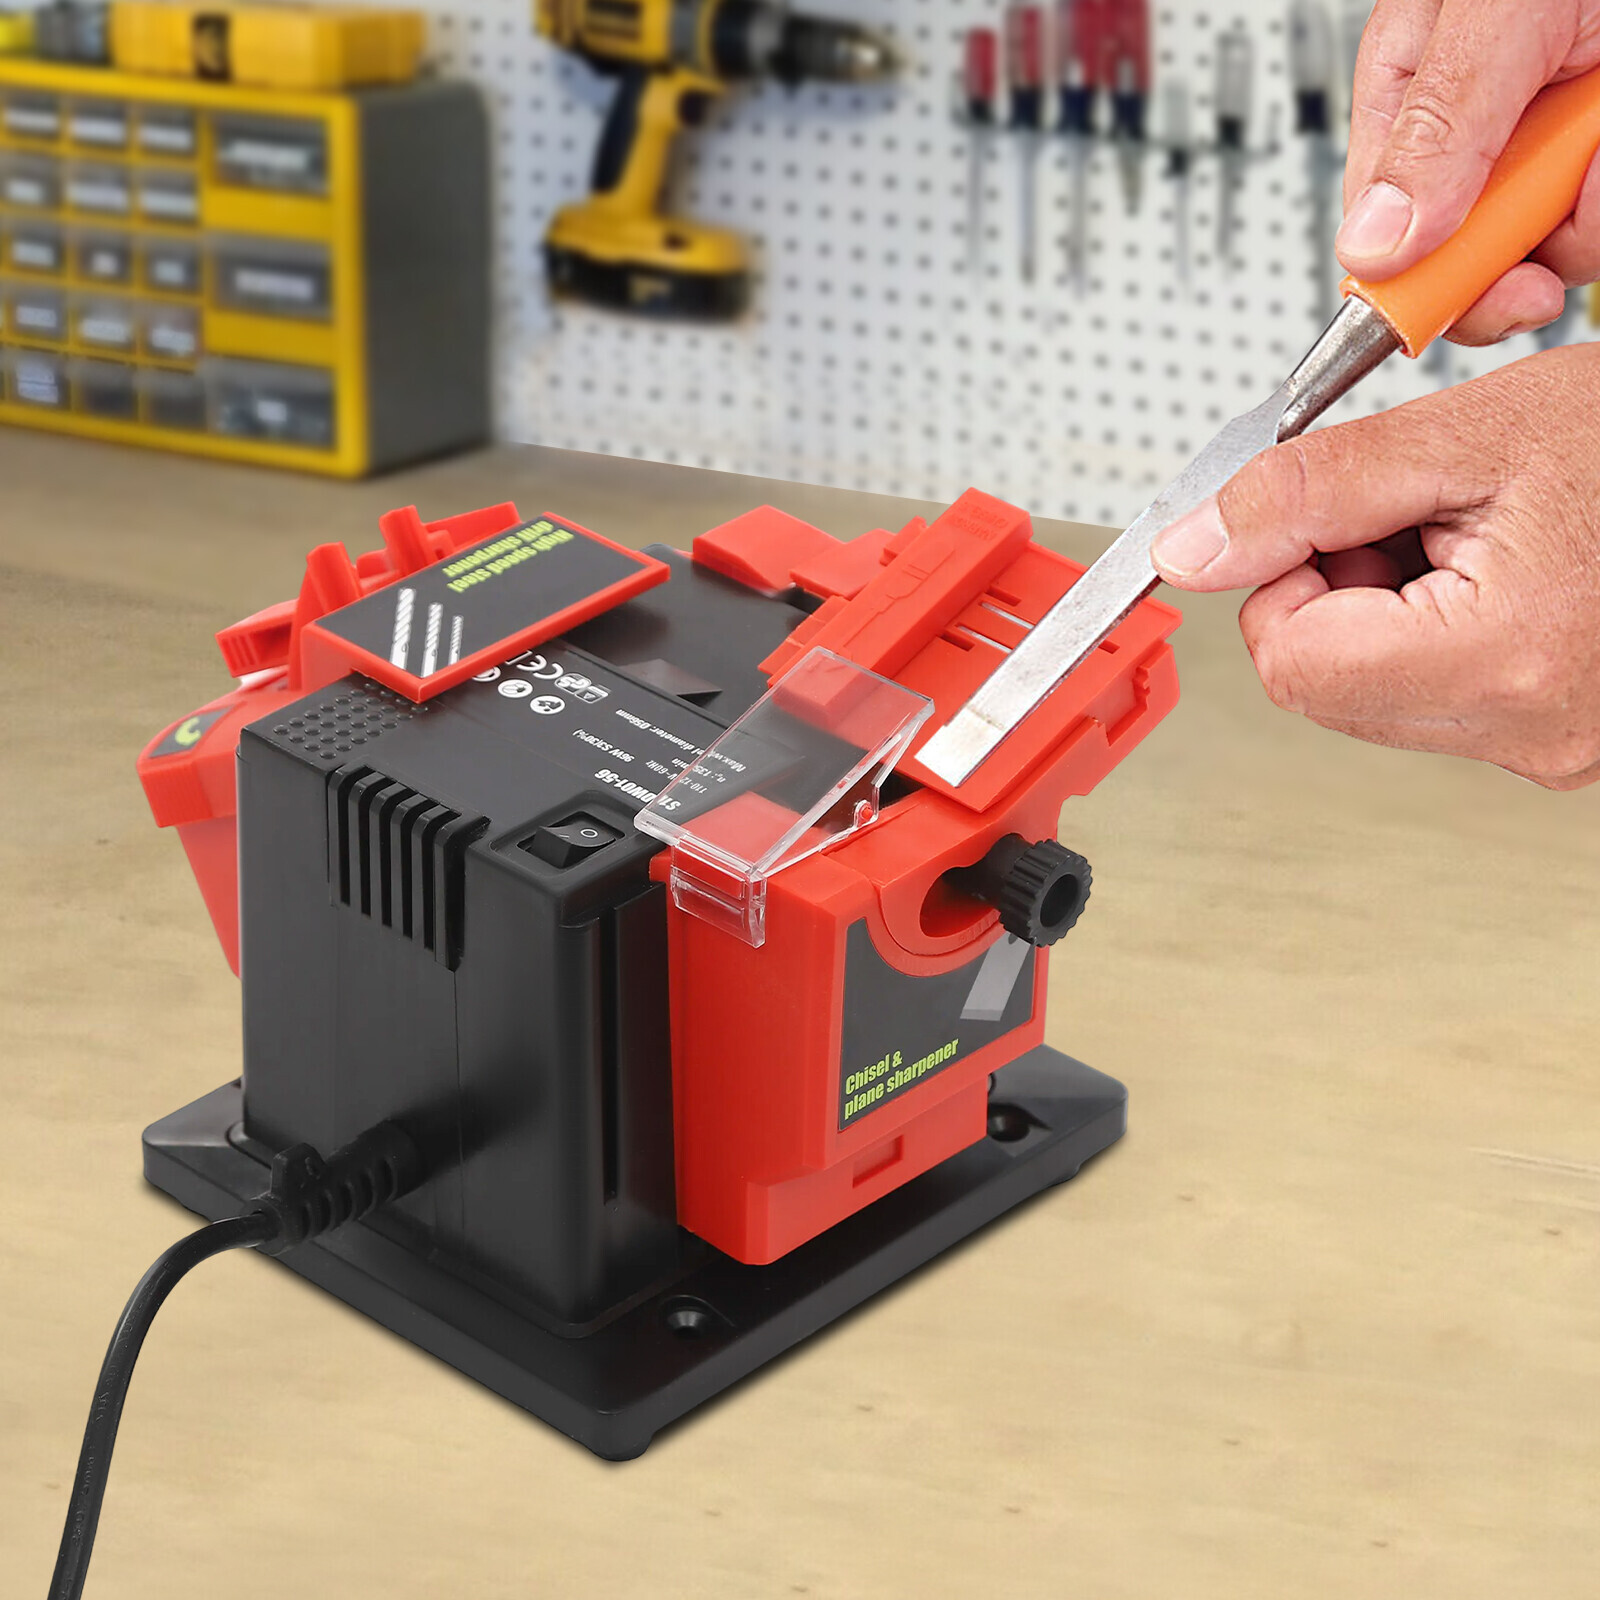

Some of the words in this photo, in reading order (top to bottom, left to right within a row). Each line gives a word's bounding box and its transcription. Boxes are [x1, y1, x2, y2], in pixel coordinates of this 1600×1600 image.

[516, 520, 554, 543] drill
[442, 535, 523, 578] sharpener
[485, 546, 538, 575] speed
[446, 568, 492, 593] steel
[608, 748, 635, 763] 96W
[844, 1082, 885, 1120] plane
[886, 1038, 959, 1093] sharpener
[845, 1053, 890, 1095] Chisel
[892, 1050, 903, 1068] &
